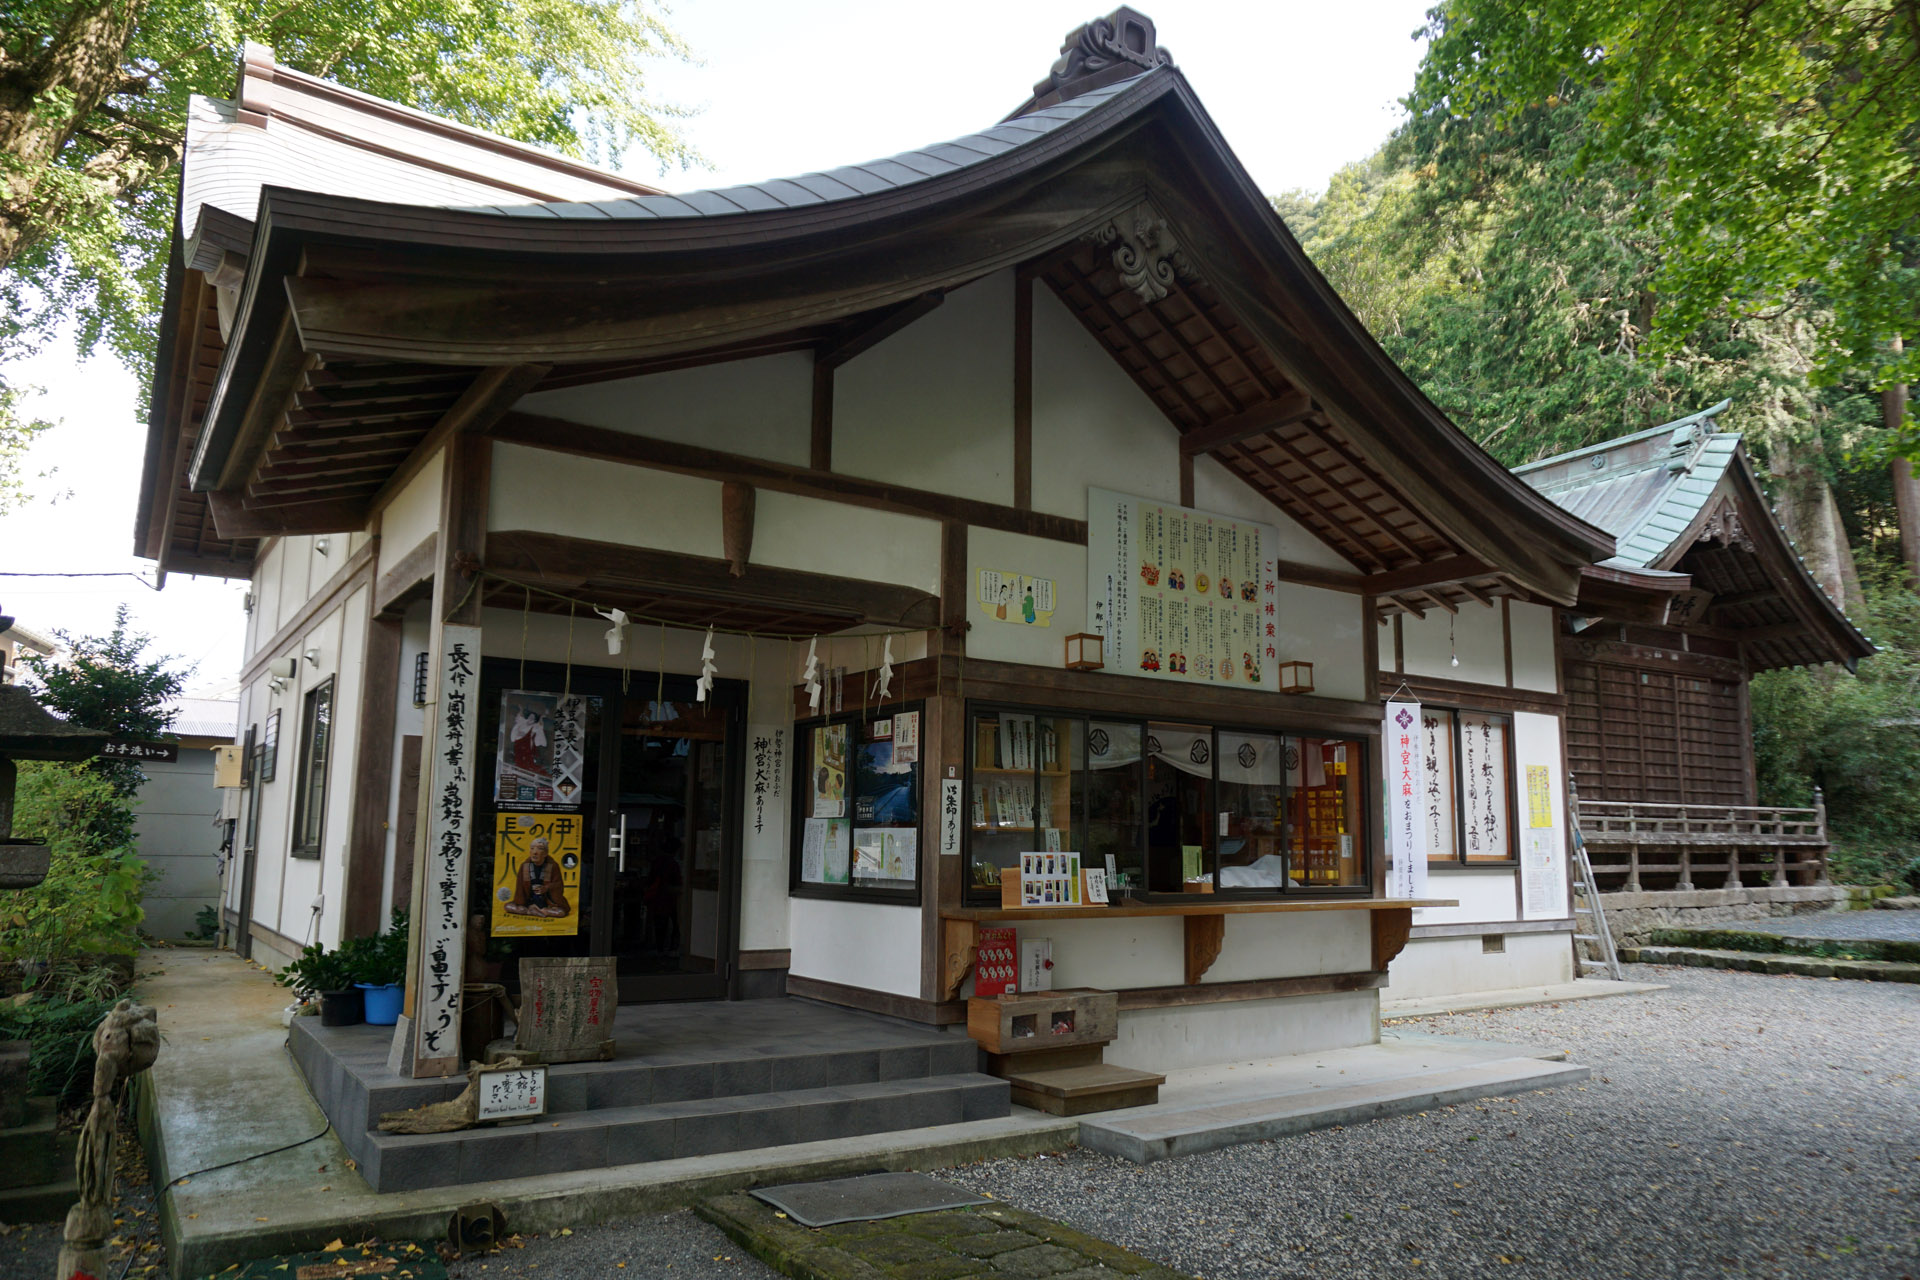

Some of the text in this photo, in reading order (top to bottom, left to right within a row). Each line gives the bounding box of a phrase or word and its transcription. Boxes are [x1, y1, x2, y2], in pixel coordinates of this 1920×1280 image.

[1095, 600, 1104, 635] 伊那下
[1264, 560, 1276, 660] ご祈祷案内
[105, 743, 155, 756] お手洗い
[564, 697, 581, 752] 伊豆の長八
[752, 736, 769, 834] 神宮大麻あります
[773, 728, 784, 798] 伊勢神宮のおふだ
[1399, 734, 1415, 898] 神宮大麻をおまつりしましょ
[529, 1070, 542, 1096] どうぞ
